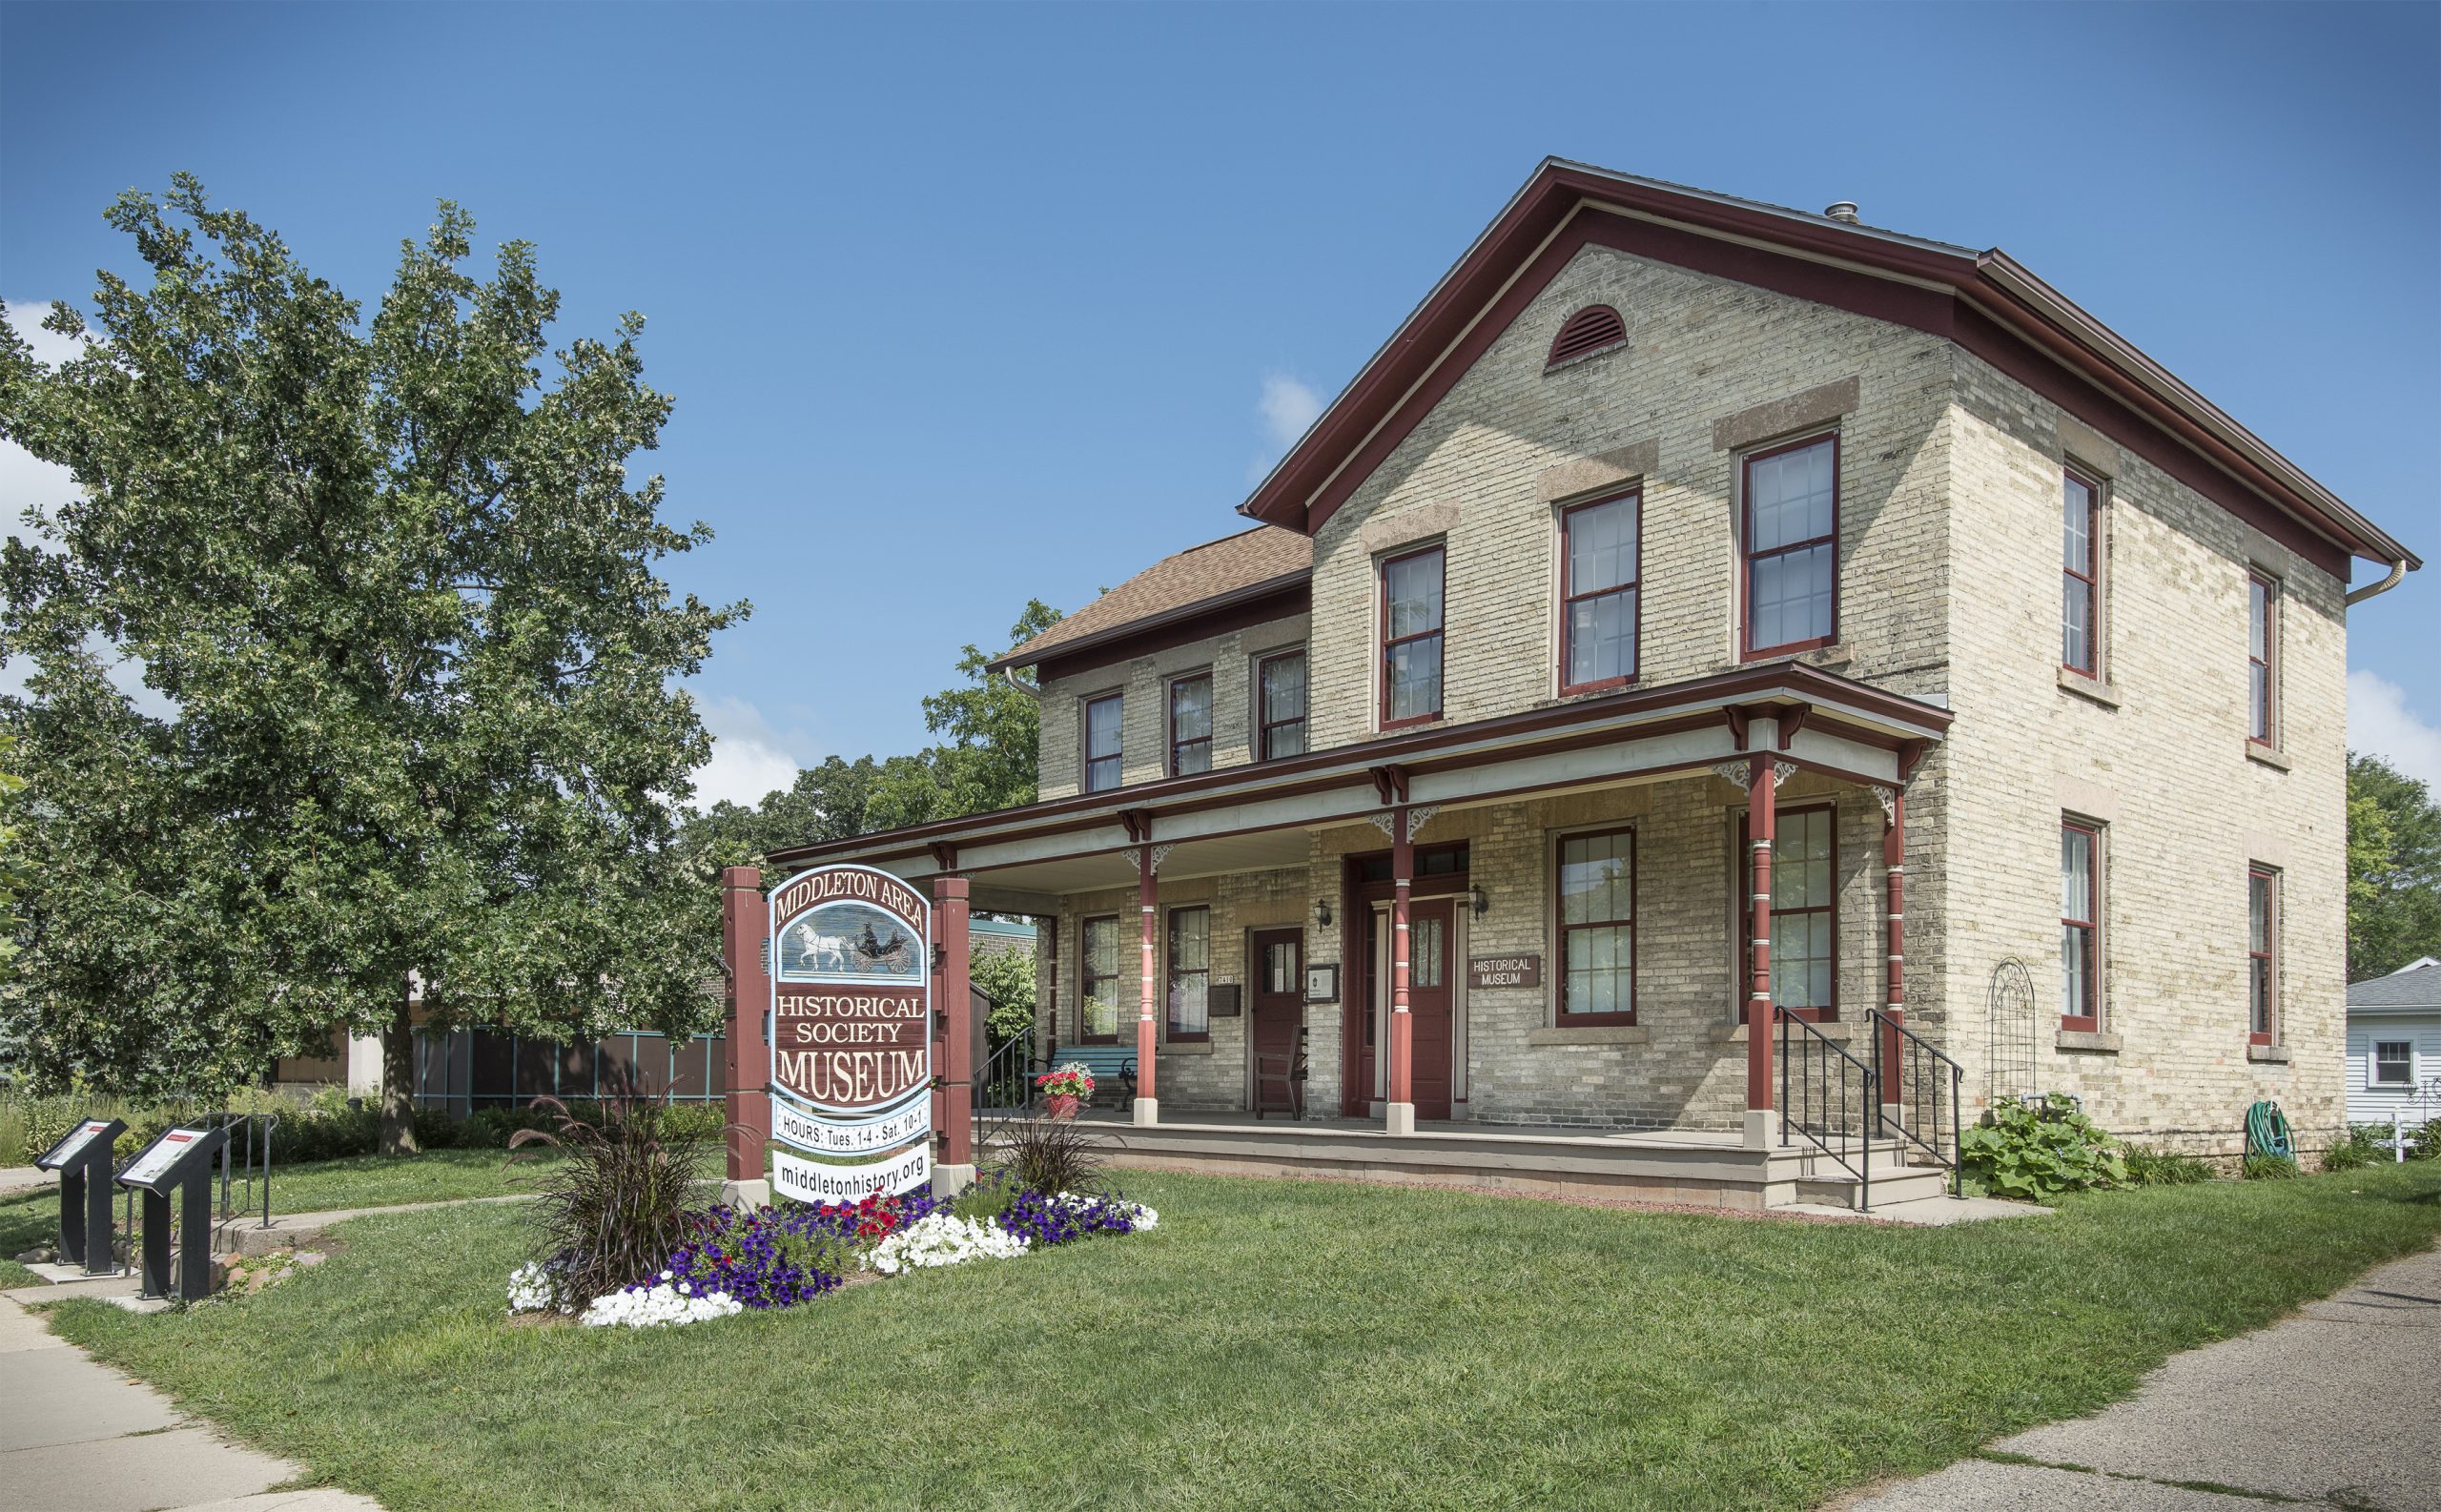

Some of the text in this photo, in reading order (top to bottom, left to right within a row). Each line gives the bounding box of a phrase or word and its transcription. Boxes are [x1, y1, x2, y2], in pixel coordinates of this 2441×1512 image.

[776, 871, 924, 935] MIDDLETON AREA
[1473, 958, 1531, 972] HISTORICAL
[1482, 972, 1521, 986] MUSEUM
[777, 995, 926, 1018] HISTORICAL
[796, 1022, 903, 1043] SOCIETY
[778, 1050, 926, 1103] MUSEUM
[783, 1115, 824, 1144] HOURS:
[828, 1130, 853, 1147] Tues.
[857, 1130, 872, 1145] 1-4
[882, 1123, 900, 1141] Sat.
[903, 1109, 922, 1133] 10-1
[782, 1154, 924, 1195] middletonhistory.org
